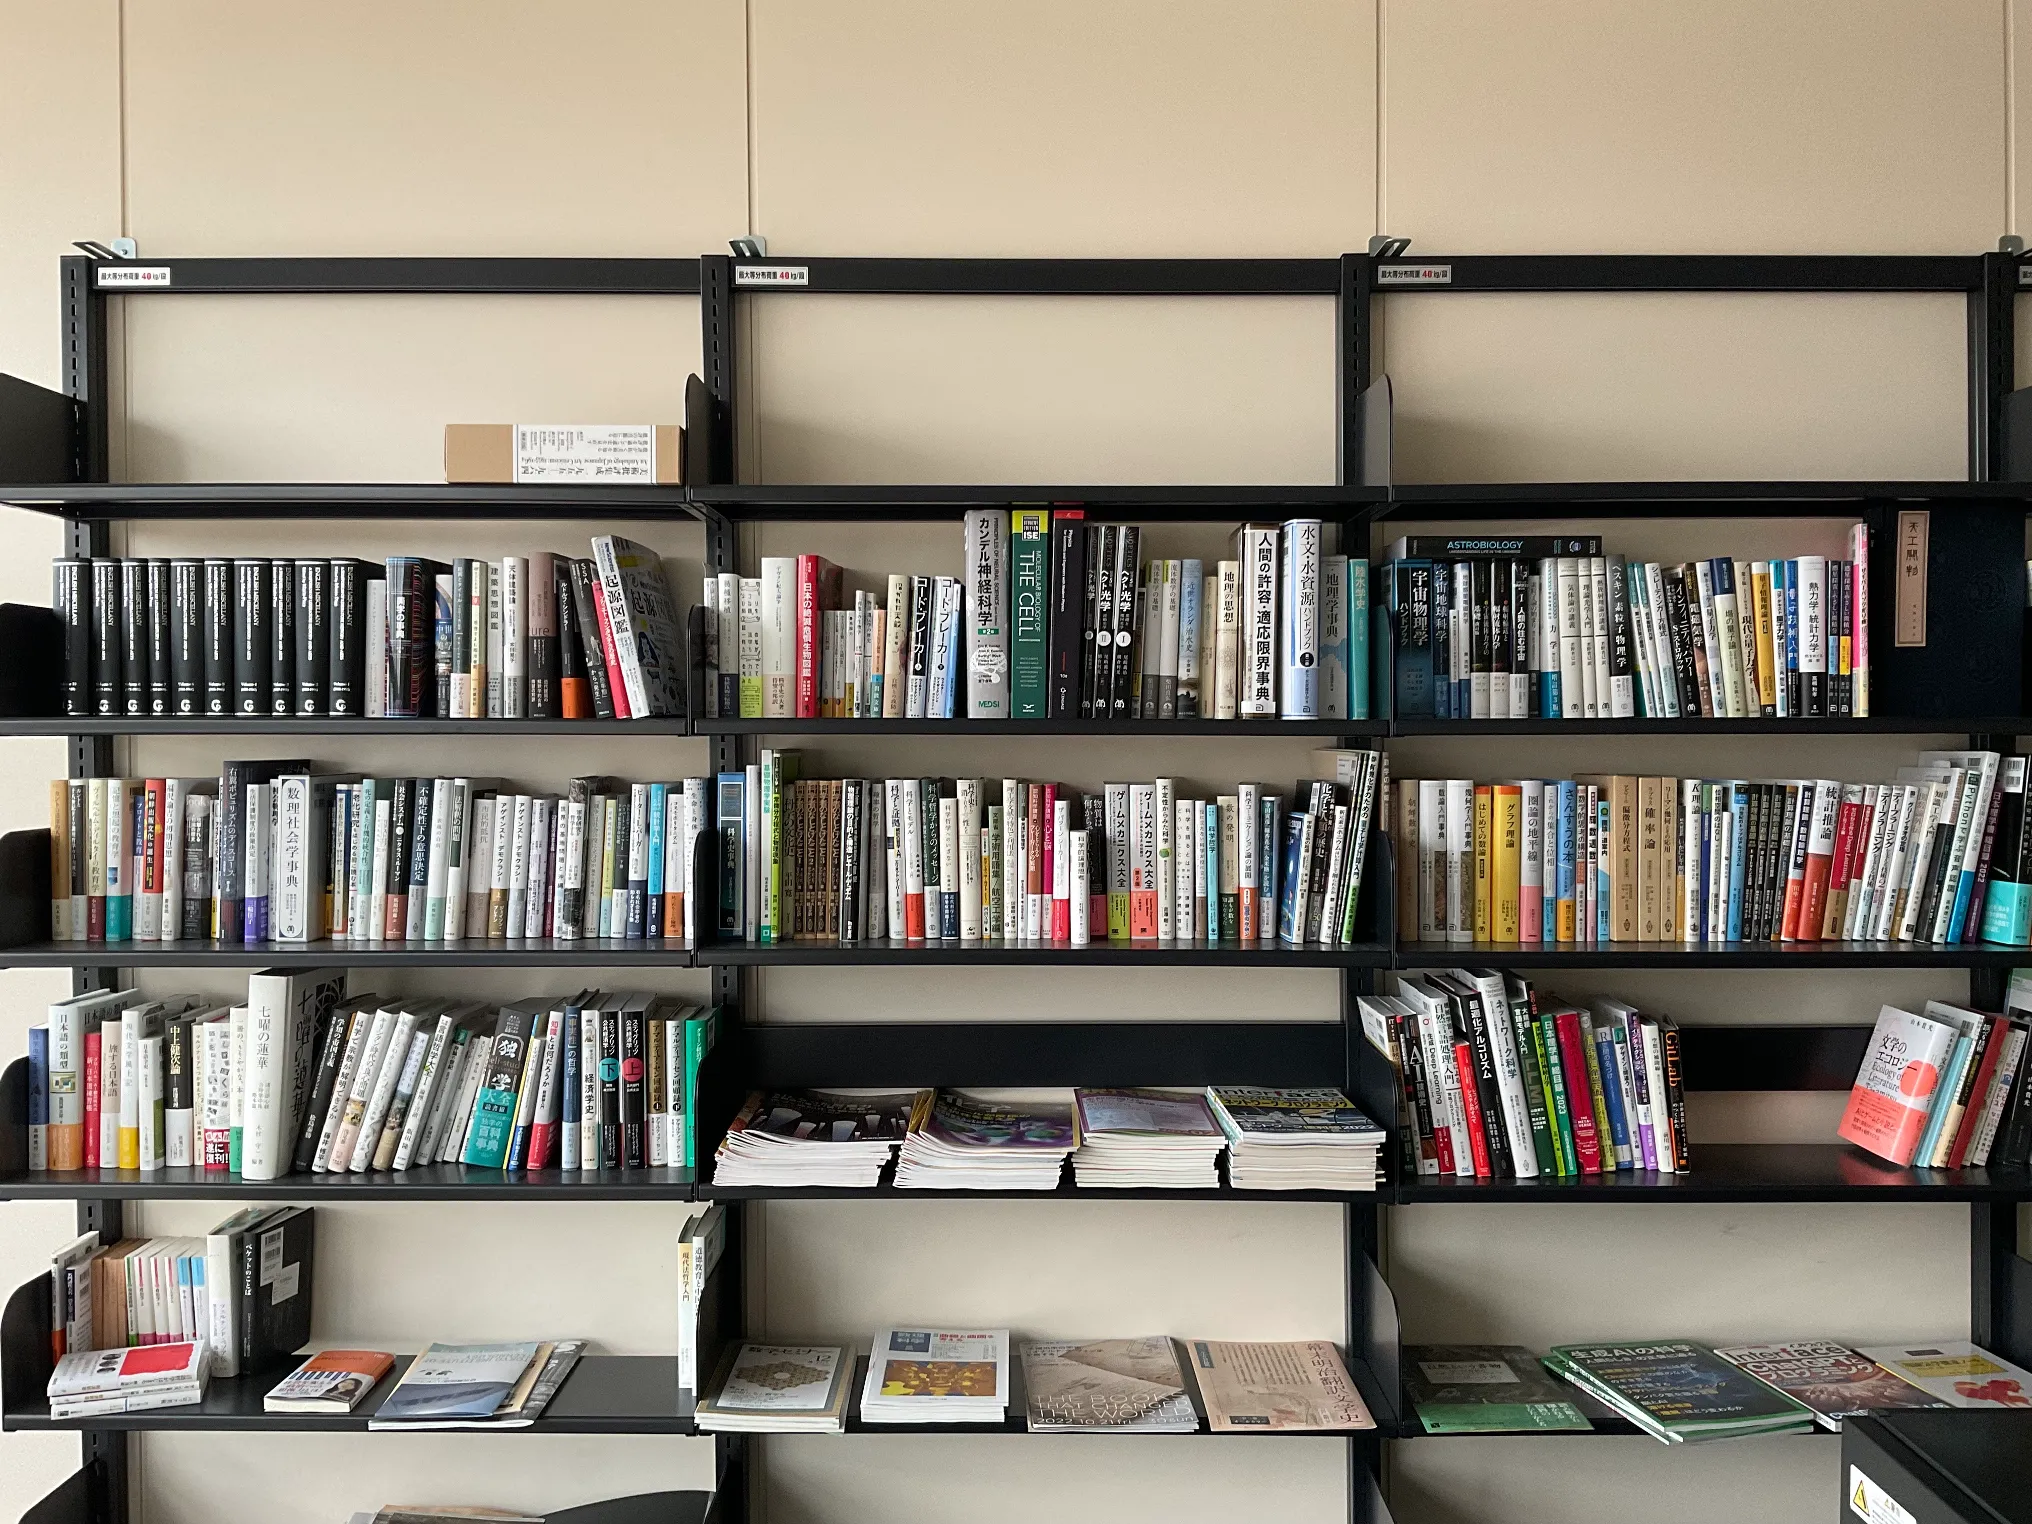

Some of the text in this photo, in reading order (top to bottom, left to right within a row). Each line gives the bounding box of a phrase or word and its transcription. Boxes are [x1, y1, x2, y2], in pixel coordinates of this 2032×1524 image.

[101, 272, 140, 281] 最大等分布荷重
[141, 272, 152, 281] 40
[738, 271, 778, 280] 最大等分布荷重
[779, 271, 790, 280] 40
[1421, 270, 1433, 279] 40
[1023, 530, 1039, 540] ISE
[1447, 540, 1524, 550] ASTROBIOLOGY
[490, 567, 499, 631] 建築思想図鑑
[580, 562, 590, 585] SSA
[977, 517, 992, 627] カンデル神経科学
[1018, 552, 1034, 637] THE CELL
[1100, 569, 1112, 612] ヘクト光学
[1121, 569, 1132, 612] ヘクト光学
[1169, 563, 1177, 612] 流体数学の基礎
[1223, 571, 1235, 624] 地理の思想
[1300, 525, 1316, 651] 水文・水資源ハンドブック
[1354, 566, 1366, 611] 陸水学史
[1759, 574, 1769, 619] 量子情報理論
[605, 573, 629, 635] 起源図鑑
[914, 577, 927, 664] コード・ブレーカー
[937, 578, 952, 664] コード・ブレーカー
[1184, 582, 1196, 653] 近世オランダ治水史
[1256, 532, 1273, 702] 人間の許容・適応限界事典
[1326, 574, 1339, 639] 地理学事典
[1400, 603, 1409, 647] ハンドブック
[1412, 571, 1428, 647] 宇宙物理学
[1435, 569, 1449, 642] 宇宙地球科学
[1651, 565, 1668, 638] シュレーディンガー方程式
[1689, 603, 1704, 648] 電磁気学
[1808, 582, 1820, 653] 熱力学・統計力学
[802, 582, 813, 677] 日本の絶滅危惧生物図鑑
[1517, 606, 1526, 662] 人類の住む宇宙
[1614, 603, 1627, 667] 素粒子物理学
[1675, 583, 1693, 678] インフィニティ・パワー
[1725, 609, 1737, 651] 場の量子論
[1742, 615, 1755, 677] 現代の量子力学
[226, 767, 238, 877] 右翼ポピュリズムのディスコース
[396, 786, 406, 827] 社会システム
[905, 790, 914, 836] 科学とモデル
[1161, 784, 1170, 846] 不定性からみた科学
[1225, 803, 1235, 845] 数の発明
[1407, 797, 1417, 849] 朝鮮数学史
[1464, 788, 1473, 849] 幾何学入門事典
[1663, 786, 1672, 853] リーマン幾何とその応用
[1691, 782, 1701, 815] K理論
[1820, 785, 1839, 841] 統計推論
[285, 787, 301, 888] 数理社会学事典
[414, 786, 429, 882] 不確定性下の意思決定
[496, 802, 508, 882] アゲインスト・デモクラシー
[514, 802, 526, 882] アゲインスト・デモクラシー
[557, 805, 566, 889] 世界の基地問題と沖縄
[726, 827, 736, 870] 科学史事典
[928, 784, 939, 883] 科学哲学からのメッセージ
[1116, 790, 1127, 889] ゲームメカニクス大全
[1144, 790, 1155, 890] ゲームメカニクス大全
[1208, 825, 1216, 854] 科学哲学
[1244, 790, 1253, 880] 科学コミュニケーション論の展開
[1477, 803, 1487, 857] はじめての数論
[1505, 803, 1515, 849] グラフ理論
[1527, 795, 1539, 863] 圏論の地平線
[1545, 792, 1556, 869] これからの集合と位相
[1561, 788, 1574, 864] さんすうの本
[1622, 805, 1631, 852] 偏微分方程式
[1644, 807, 1656, 850] 確率論
[394, 836, 403, 882] ニクラス・ルーマン
[1840, 854, 1850, 883] Learning
[1976, 863, 1988, 884] 2022
[59, 1014, 69, 1070] 日本語の類型
[170, 1025, 181, 1075] 中上健次論
[256, 1005, 272, 1071] 七曜の蓮華
[497, 1039, 518, 1058] 独
[567, 1013, 578, 1077] 「事実性」の哲学
[625, 1018, 633, 1049] 公共経済学
[1434, 1002, 1455, 1086] 自然言語処理入門
[1468, 1000, 1493, 1079] 最適化アルゴリズム
[1495, 999, 1518, 1080] ネットワーク科学
[1513, 1008, 1529, 1054] 言語モデル入門
[1879, 1034, 1908, 1055] 文学の
[1910, 1018, 1934, 1034] 山本貴光
[107, 1043, 118, 1097] 旅する日本語
[125, 1022, 133, 1089] 現代文学風土記
[328, 1018, 364, 1121] 科学で宗教が解明できるか
[541, 1019, 560, 1089] 知識とは何だろうか
[605, 1063, 615, 1078] 下
[625, 1062, 641, 1077] 上
[652, 1024, 662, 1103] アマルティア・セン回顧録
[672, 1024, 682, 1104] アマルティア・セン回顧録
[1429, 1048, 1443, 1105] Deep Learning
[1665, 1031, 1679, 1088] GitLab
[1875, 1051, 1918, 1071] エコロジー
[490, 1073, 512, 1092] 学
[584, 1073, 595, 1115] 経済学史
[1223, 1099, 1348, 1109] ネットワーク プログラミング
[1556, 1094, 1567, 1114] 2023
[206, 1143, 225, 1154] 遂に
[681, 1251, 692, 1304] 現代法哲学入門
[747, 1345, 834, 1356] 数学セミナー
[1570, 1344, 1694, 1358] 生成AIの科学
[1725, 1346, 1846, 1366] Interface
[1757, 1362, 1875, 1380] プログラミング
[1037, 1406, 1192, 1419] THE WORLD
[1091, 1400, 1190, 1410] CHANGED
